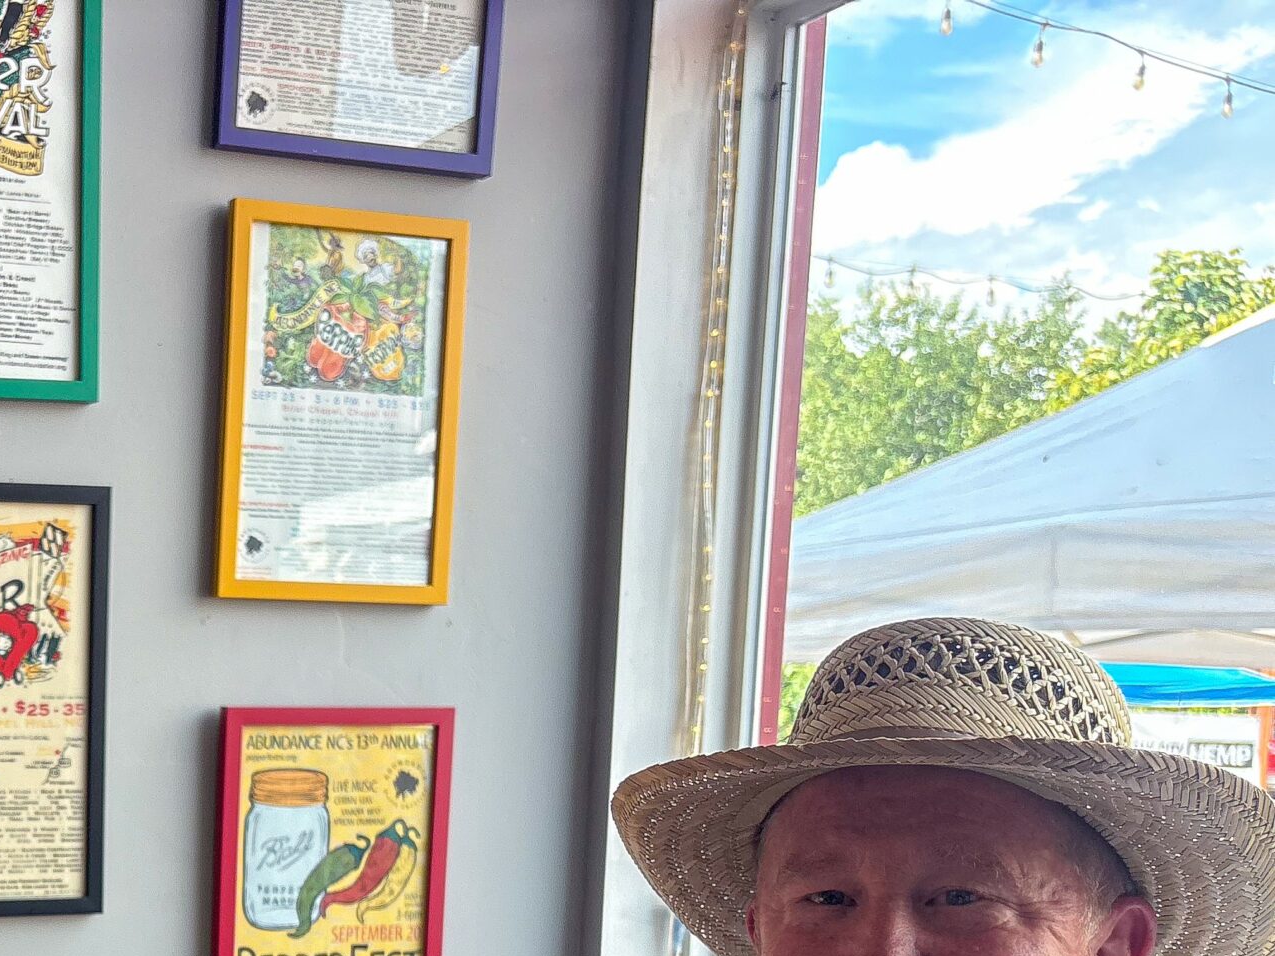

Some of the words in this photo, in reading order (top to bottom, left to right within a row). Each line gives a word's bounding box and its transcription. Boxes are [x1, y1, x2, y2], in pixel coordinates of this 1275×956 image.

[246, 735, 322, 750] ABUNDANCE
[1188, 743, 1252, 767] HEMP
[333, 780, 349, 793] LIVE
[331, 925, 403, 943] SEPTEMBER
